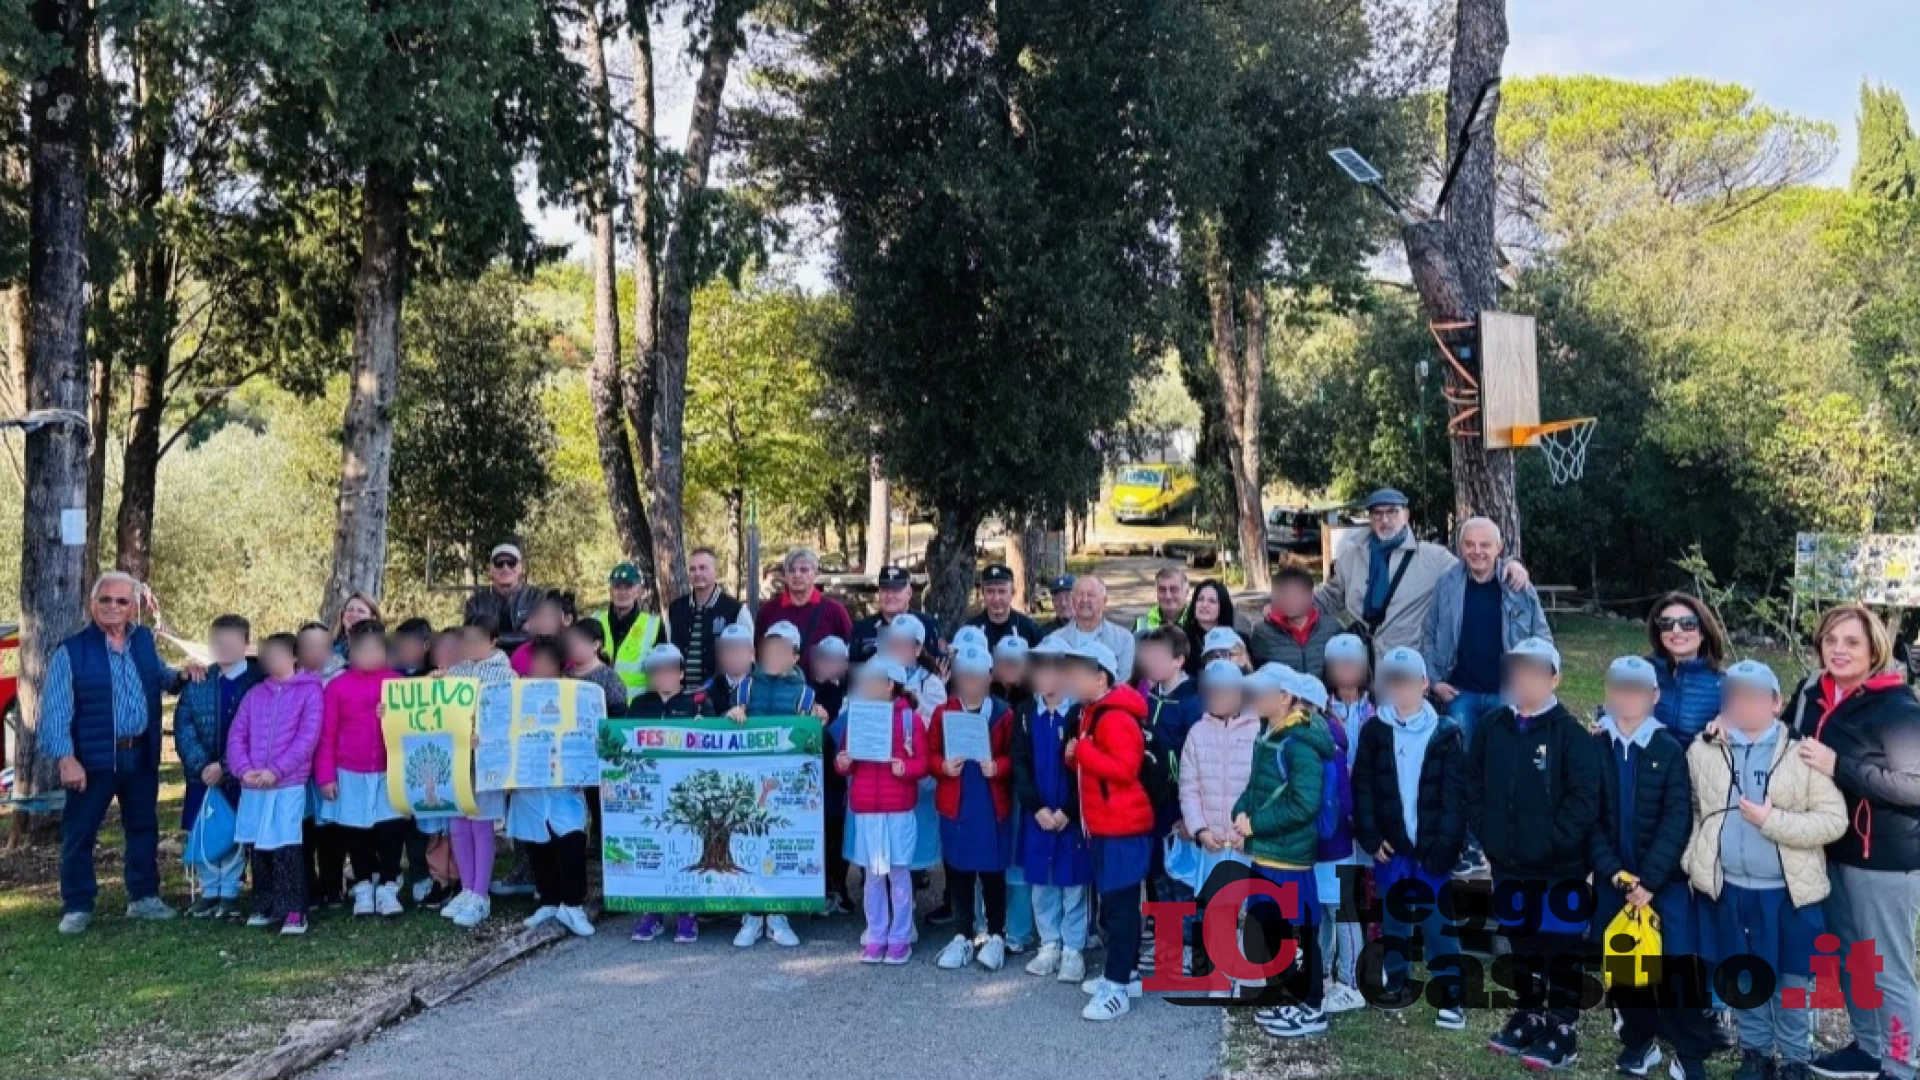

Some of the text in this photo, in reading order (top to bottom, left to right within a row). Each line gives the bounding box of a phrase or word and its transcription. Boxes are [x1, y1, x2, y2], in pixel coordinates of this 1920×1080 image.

[388, 679, 474, 709] L'ULIVO
[687, 731, 723, 748] DEGLI
[728, 731, 779, 749] ALBERI
[664, 884, 700, 895] PACE
